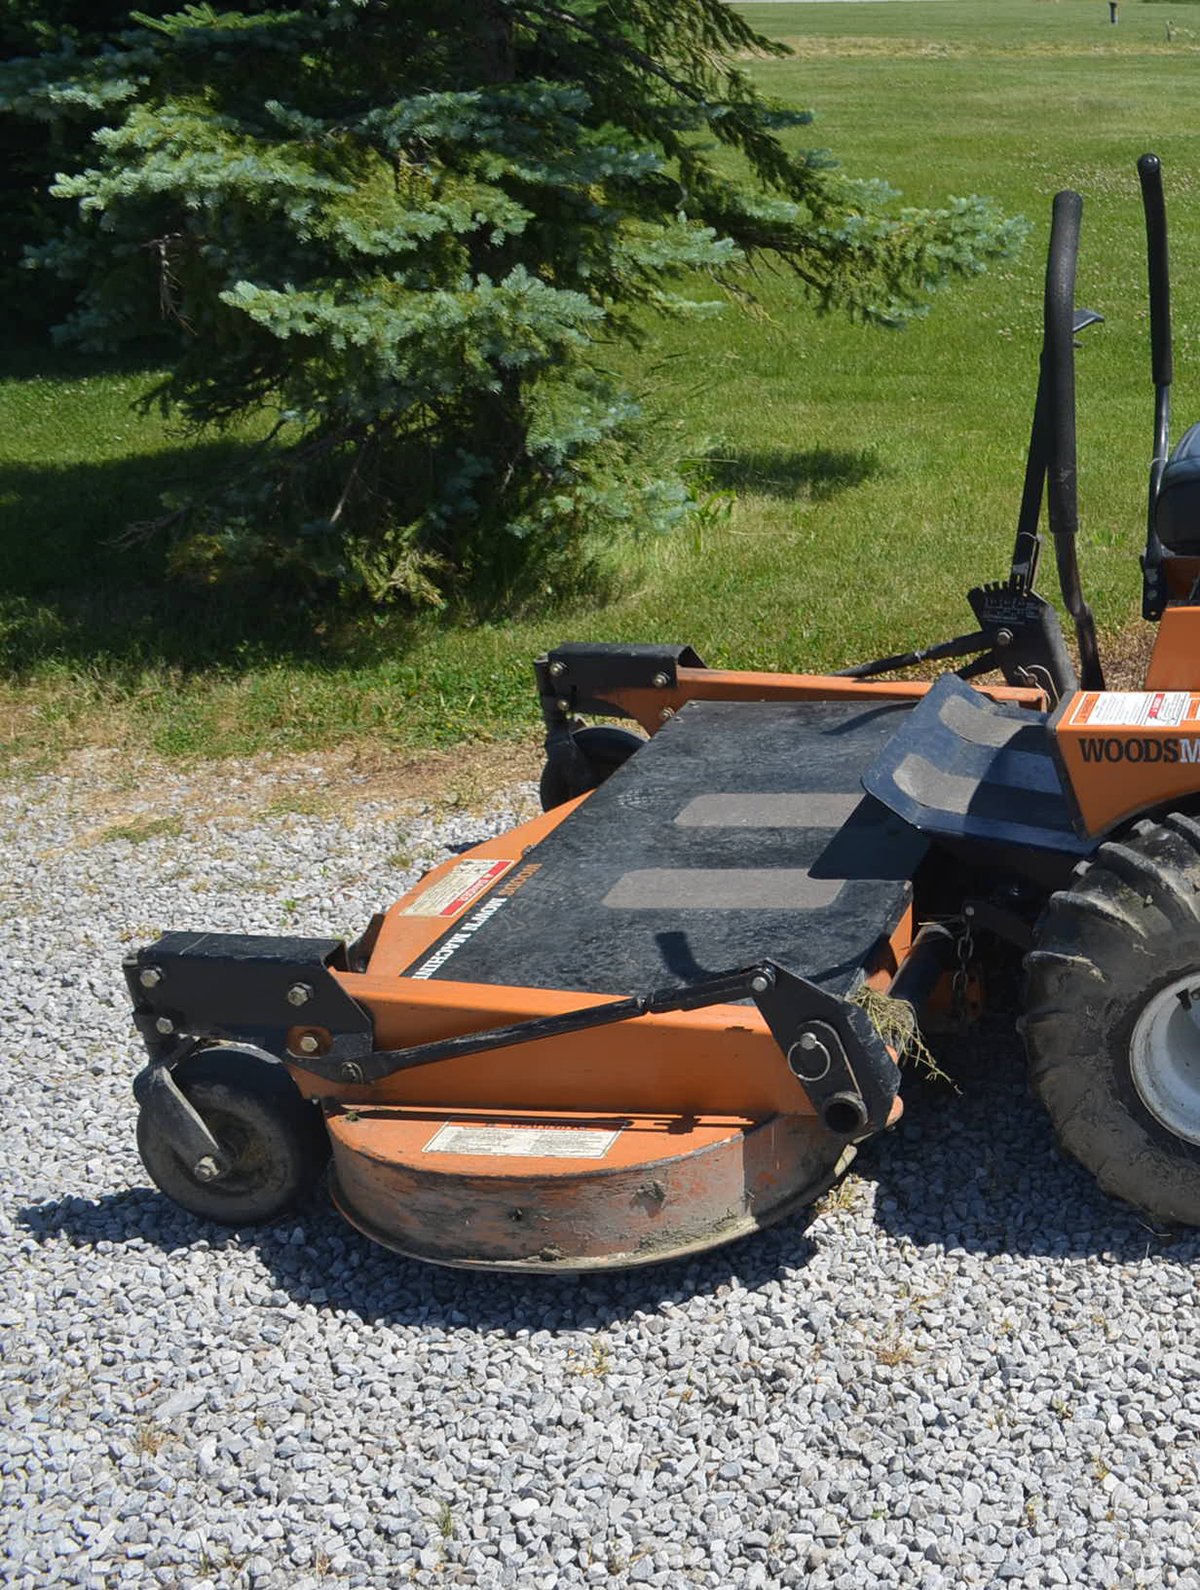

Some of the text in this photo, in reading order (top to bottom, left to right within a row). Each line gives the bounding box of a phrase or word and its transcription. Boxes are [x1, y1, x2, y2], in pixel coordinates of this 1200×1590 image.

[1078, 738, 1180, 763] WOODS
[498, 863, 543, 896] WOODS
[460, 897, 508, 931] MOW'N
